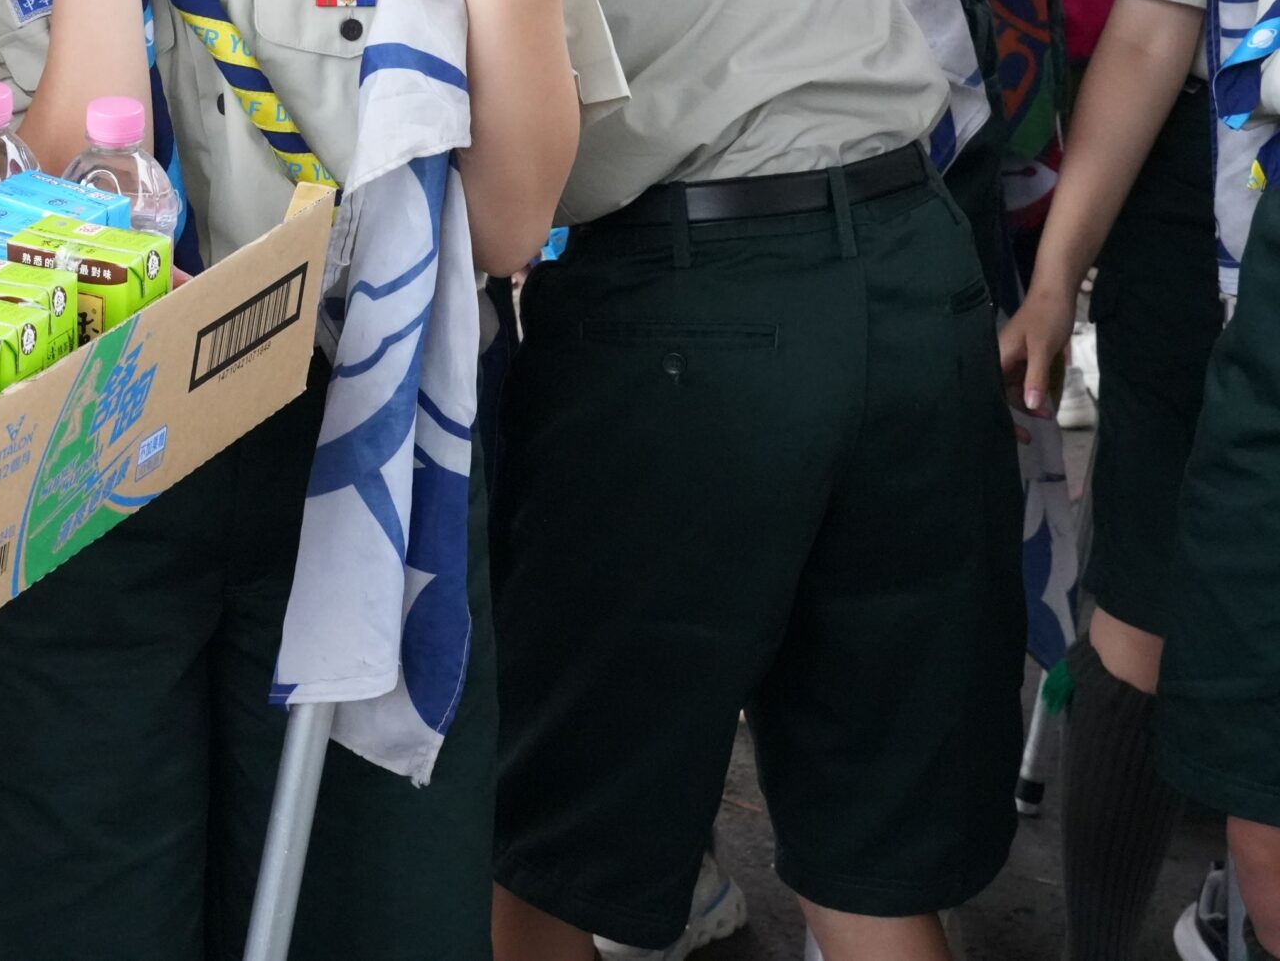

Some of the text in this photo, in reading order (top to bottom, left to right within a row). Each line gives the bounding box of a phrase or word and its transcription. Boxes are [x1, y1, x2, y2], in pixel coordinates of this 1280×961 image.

[22, 251, 113, 281] 熟悉的最對味
